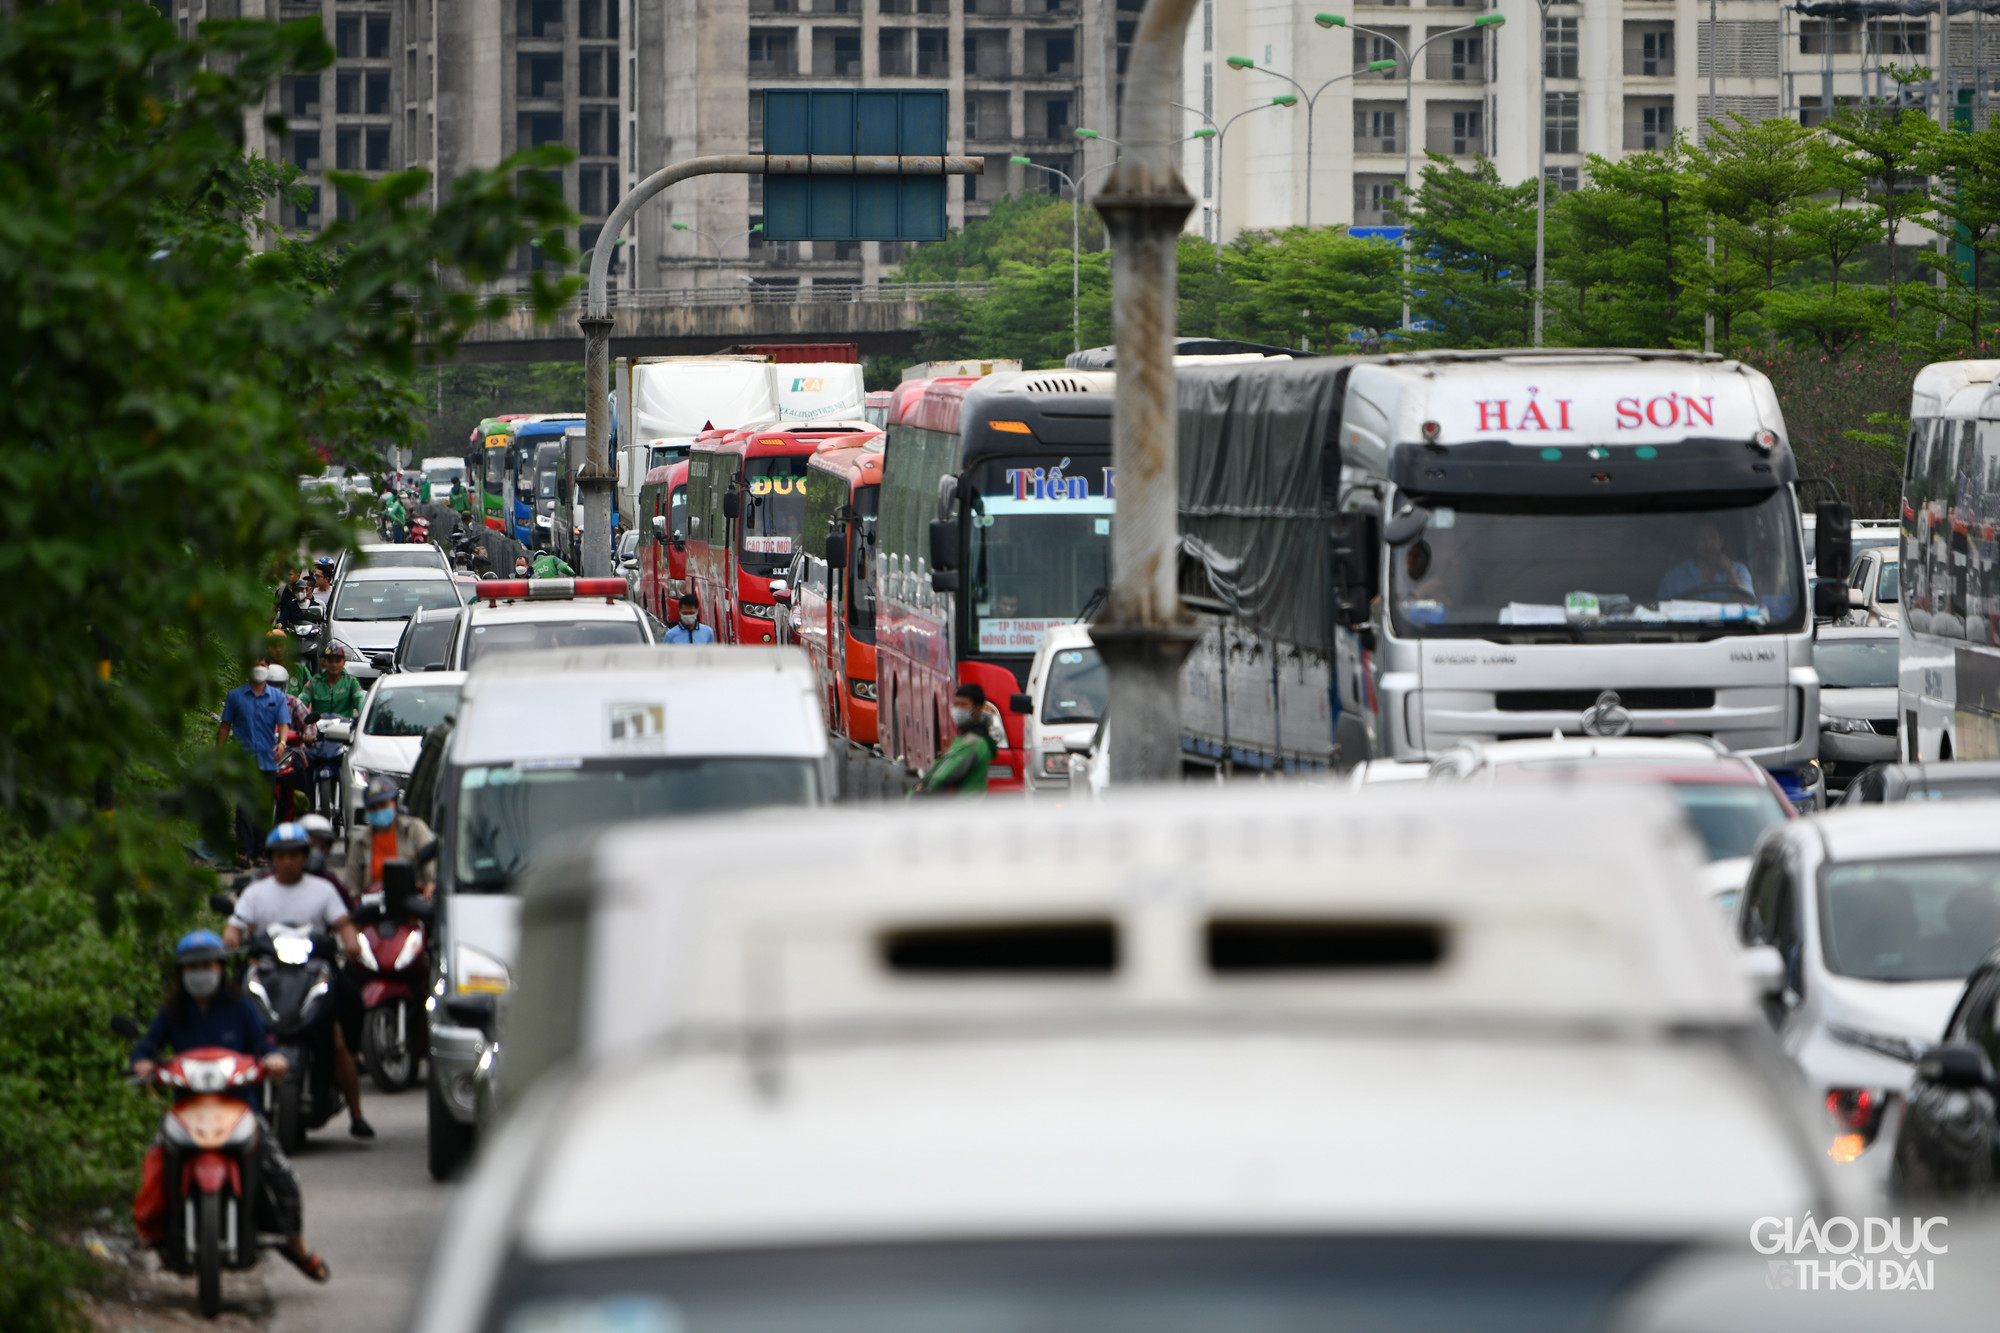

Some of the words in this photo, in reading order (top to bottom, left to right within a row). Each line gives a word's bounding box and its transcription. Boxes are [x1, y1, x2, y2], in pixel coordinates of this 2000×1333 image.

[793, 378, 823, 392] KA
[1474, 386, 1574, 431] HẢI
[1616, 391, 1715, 431] SƠN
[1006, 457, 1088, 501] Tiến
[998, 621, 1010, 632] TP
[1013, 621, 1044, 632] THANH
